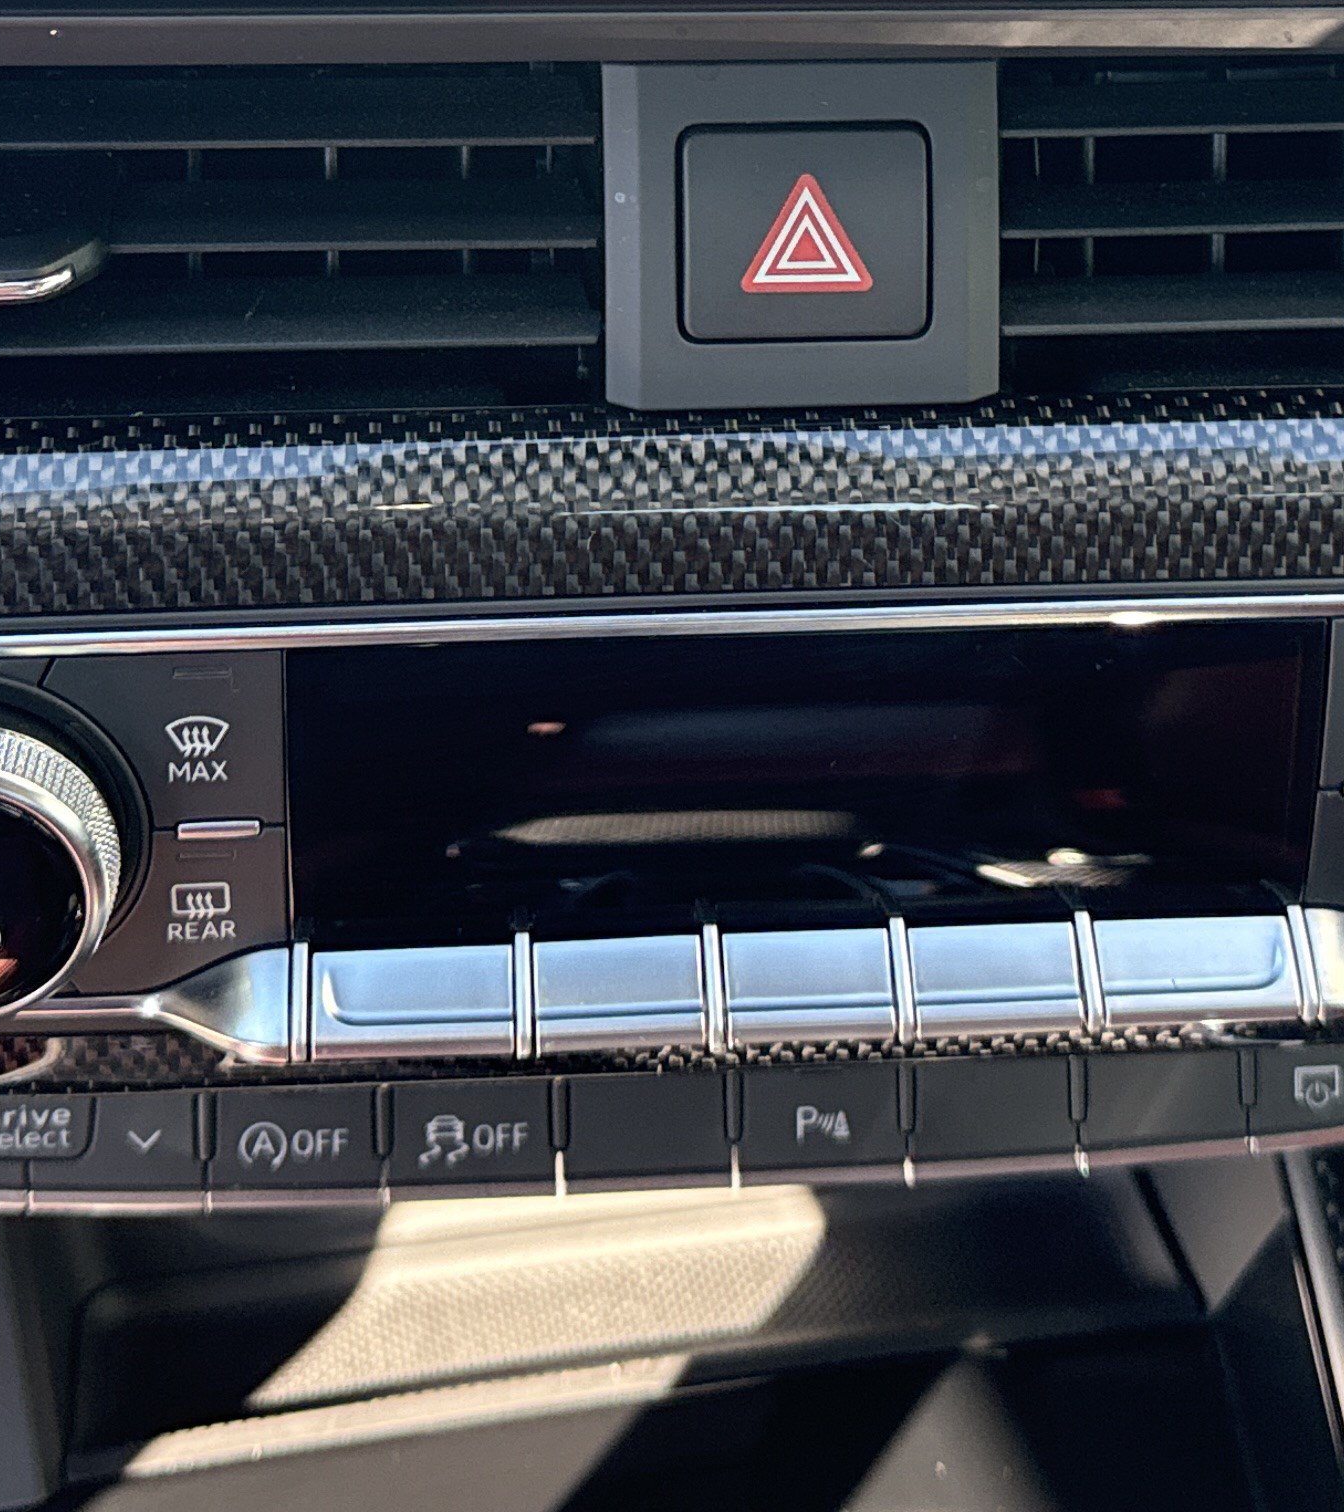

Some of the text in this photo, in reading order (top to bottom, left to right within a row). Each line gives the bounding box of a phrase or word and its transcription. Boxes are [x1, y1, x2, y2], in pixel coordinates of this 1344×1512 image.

[168, 760, 228, 782] MAX
[167, 918, 236, 941] REAR
[291, 1128, 347, 1158] OFF
[472, 1122, 527, 1152] OFF
